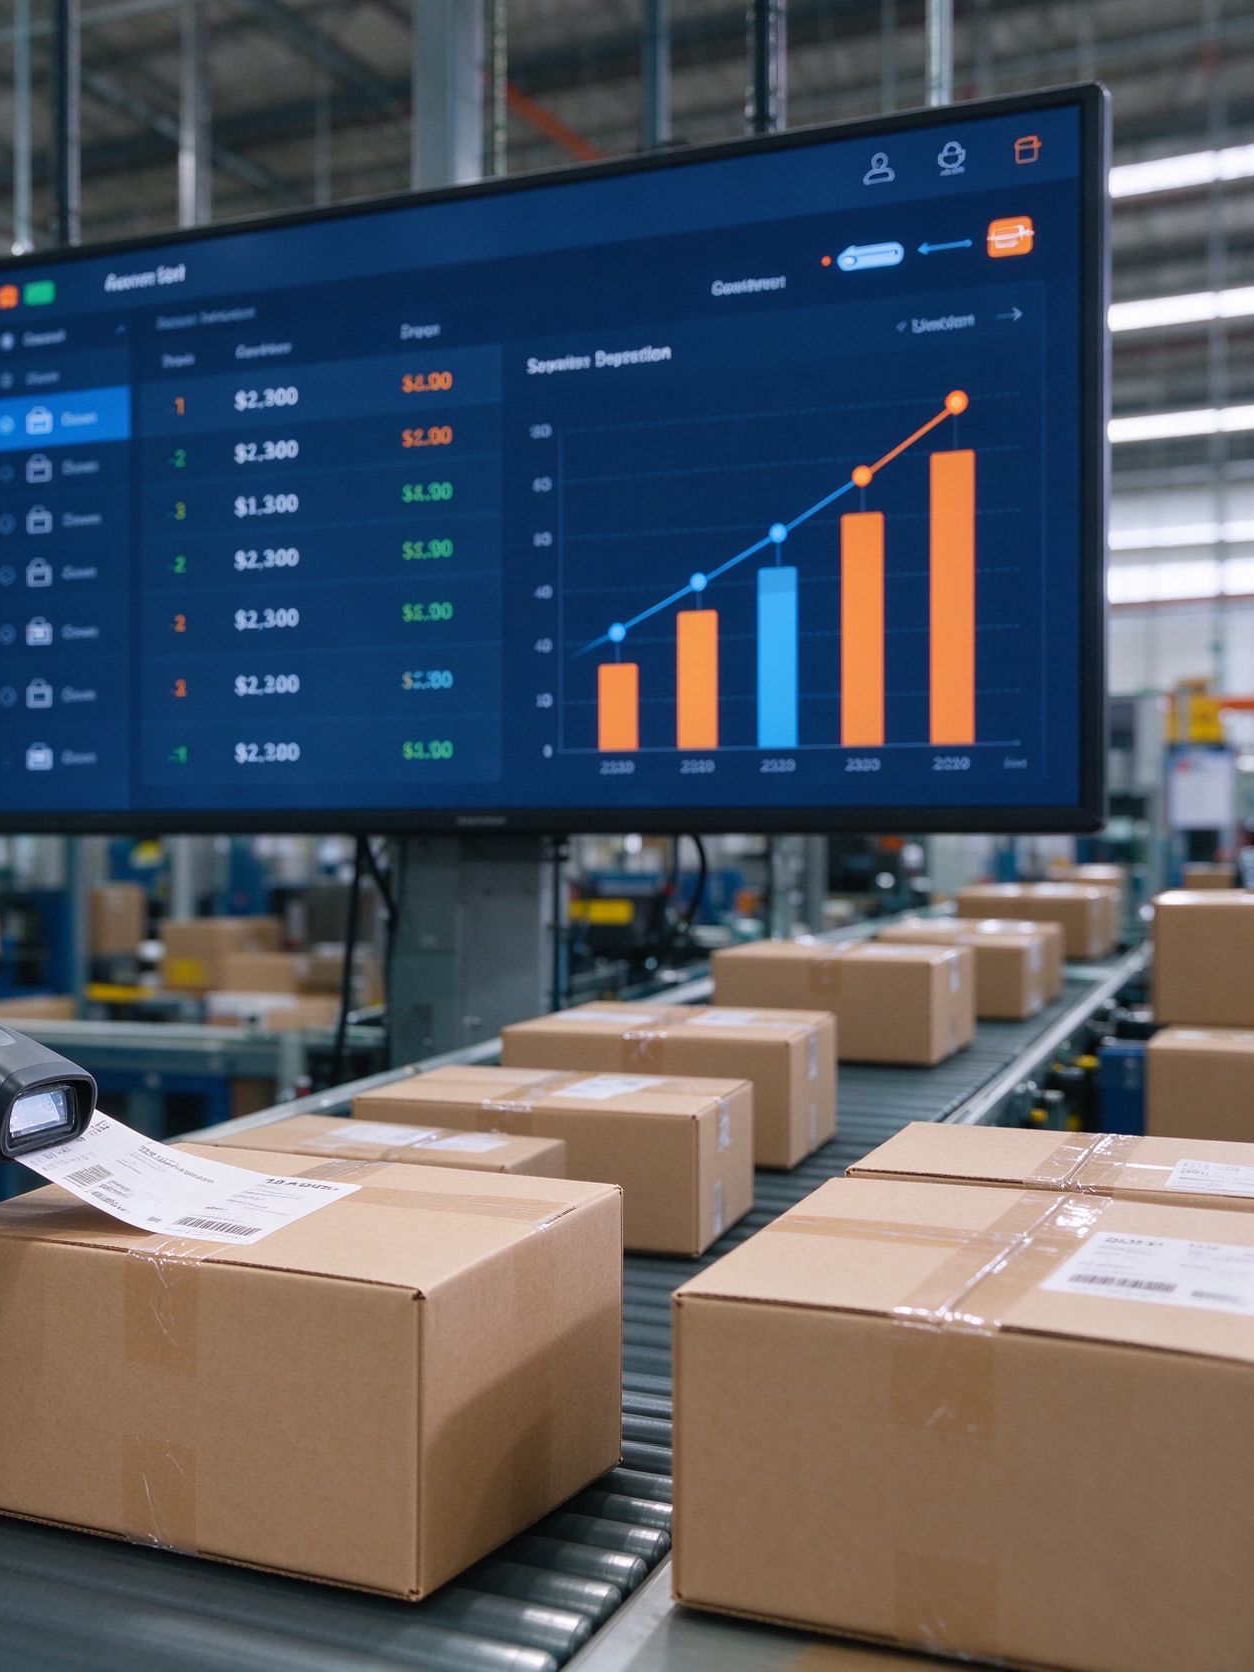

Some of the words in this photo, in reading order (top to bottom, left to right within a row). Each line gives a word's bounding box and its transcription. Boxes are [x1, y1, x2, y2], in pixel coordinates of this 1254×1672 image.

[234, 386, 299, 412] $2,300
[234, 439, 299, 465] $2,300
[234, 493, 299, 518] $1,300
[234, 607, 300, 631] $2,300
